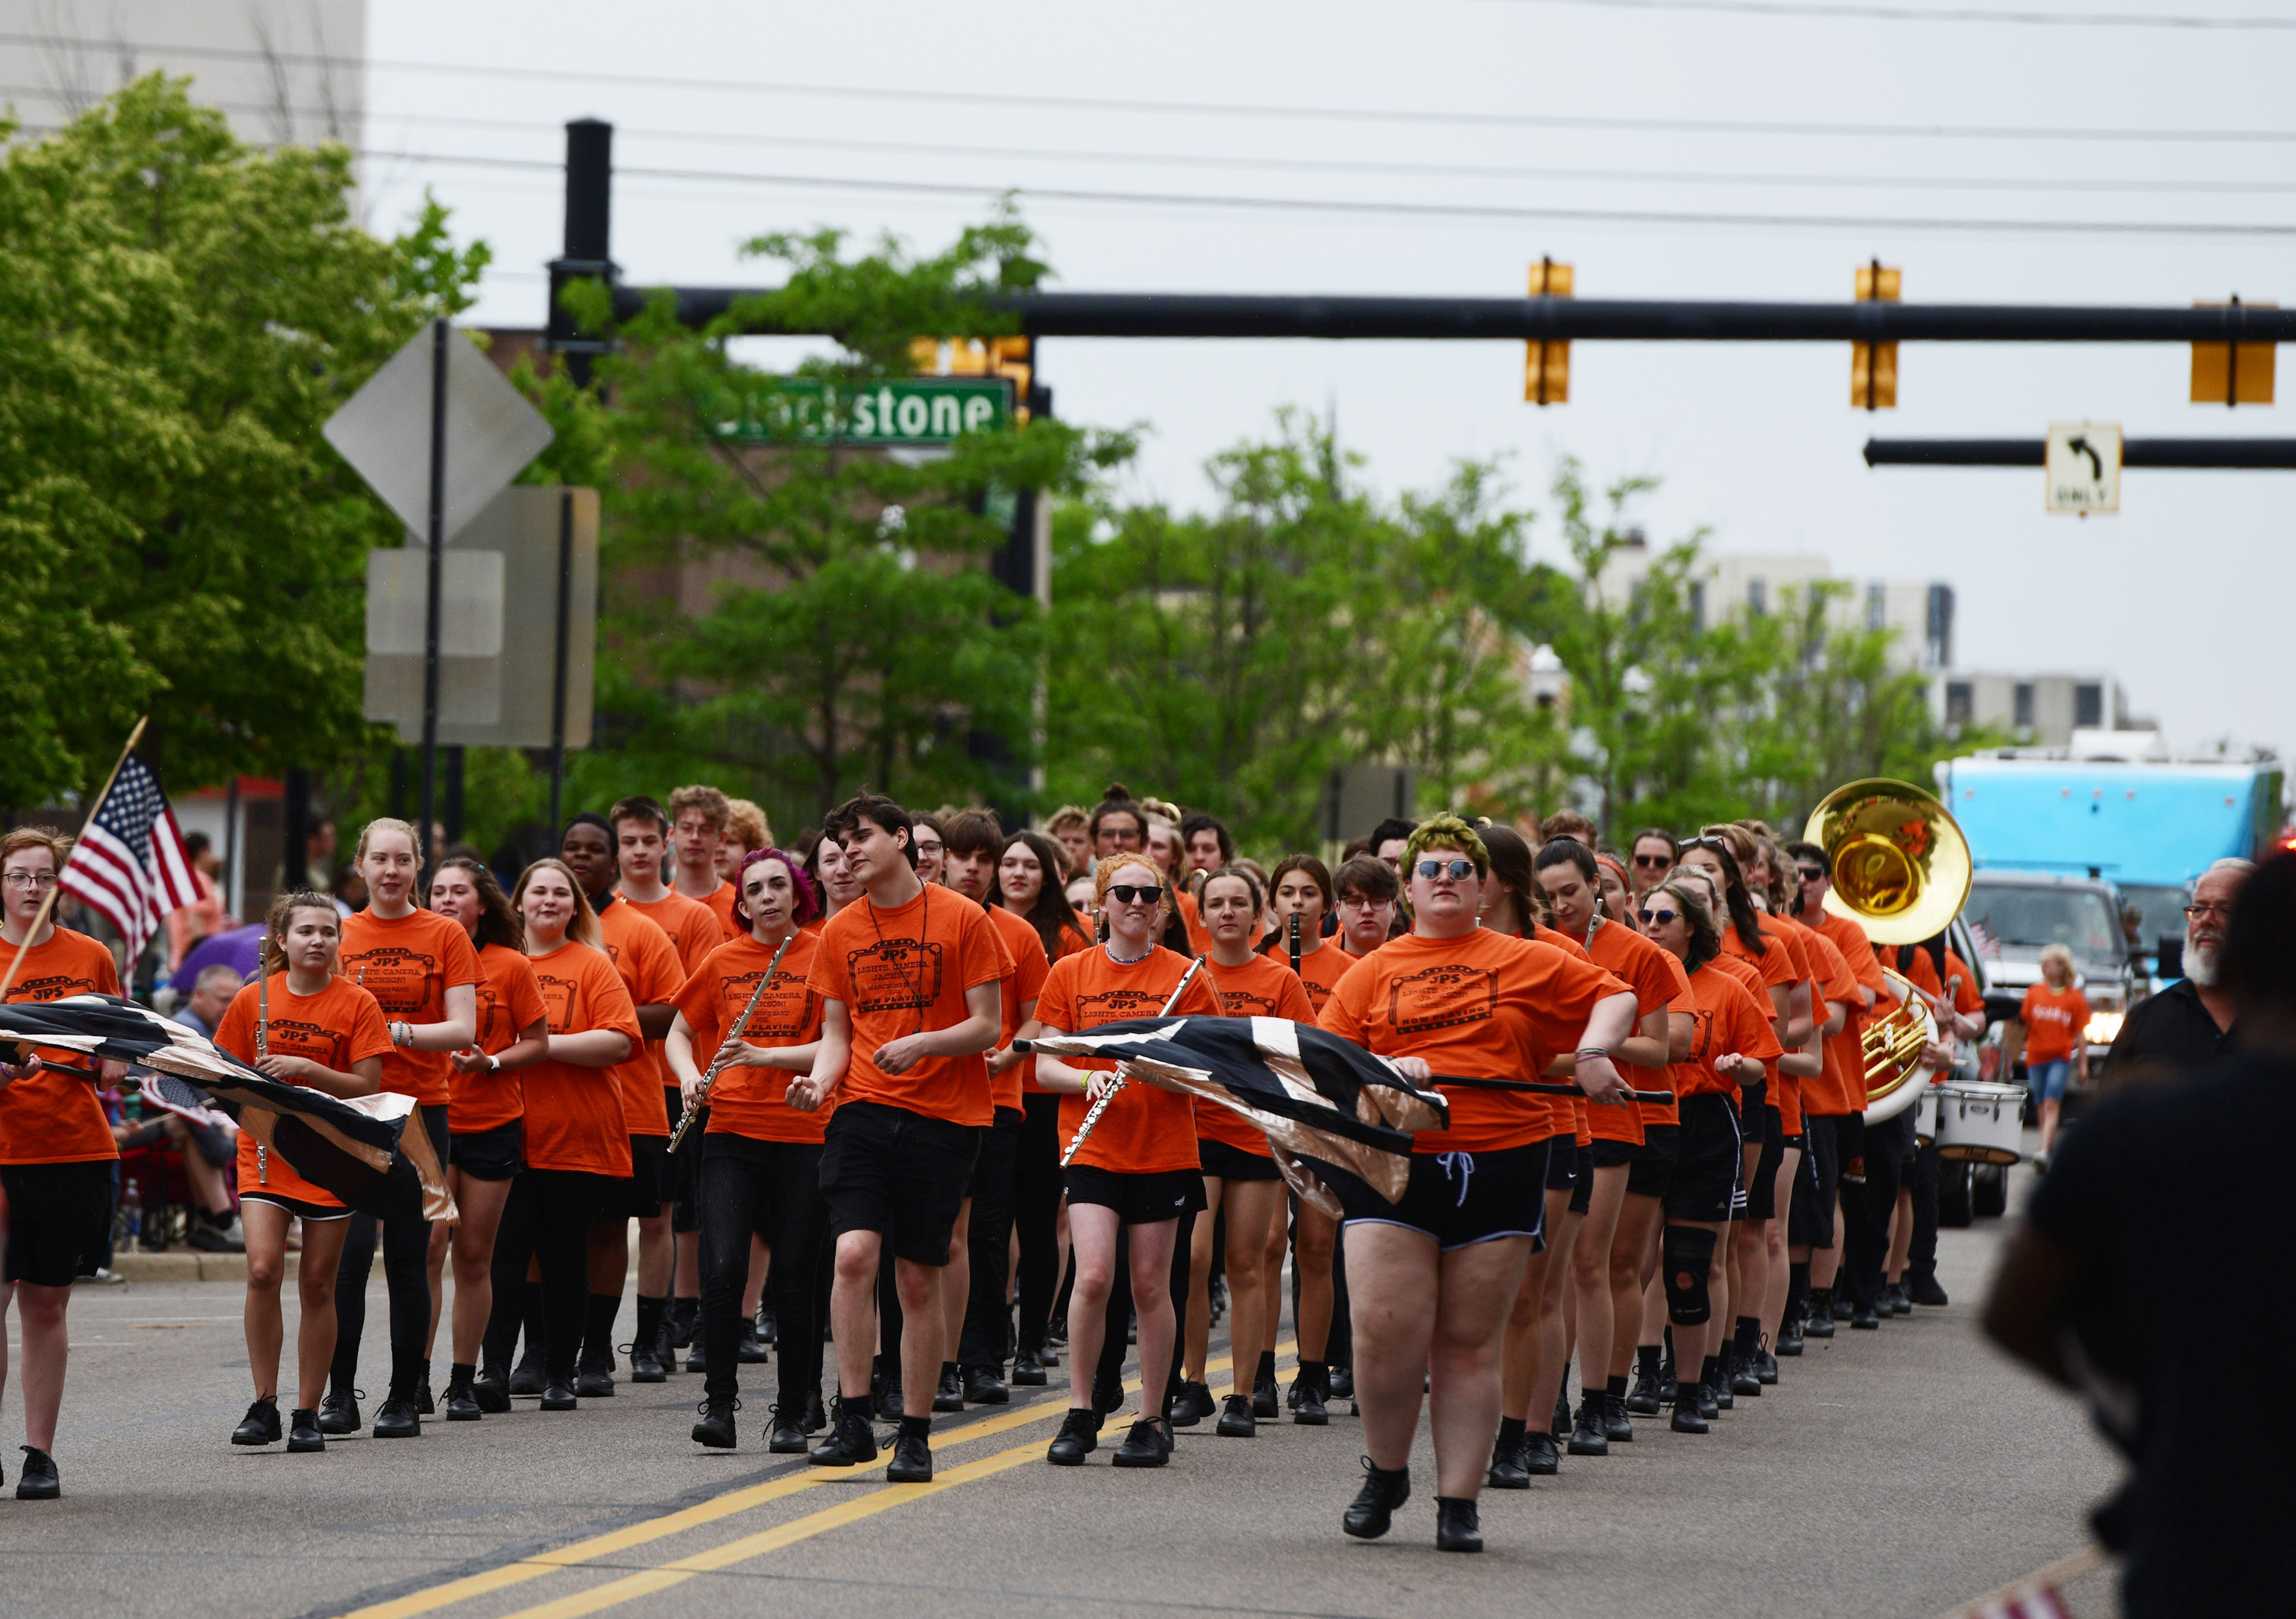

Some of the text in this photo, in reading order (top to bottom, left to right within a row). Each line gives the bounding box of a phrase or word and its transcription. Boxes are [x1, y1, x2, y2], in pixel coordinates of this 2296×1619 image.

[2057, 487, 2106, 504] ONLY
[880, 949, 907, 961] JPS
[373, 957, 400, 967] JPS
[857, 965, 891, 974] LIGHTS,
[872, 971, 914, 981] JACKSON!
[1429, 973, 1460, 984] JPS
[33, 986, 64, 1000] JPS
[1108, 1000, 1137, 1009] JPS
[1225, 1000, 1243, 1009] PS
[1402, 1016, 1428, 1025] NOW
[1433, 1006, 1485, 1020] PLAYING
[280, 1030, 309, 1042] JPS
